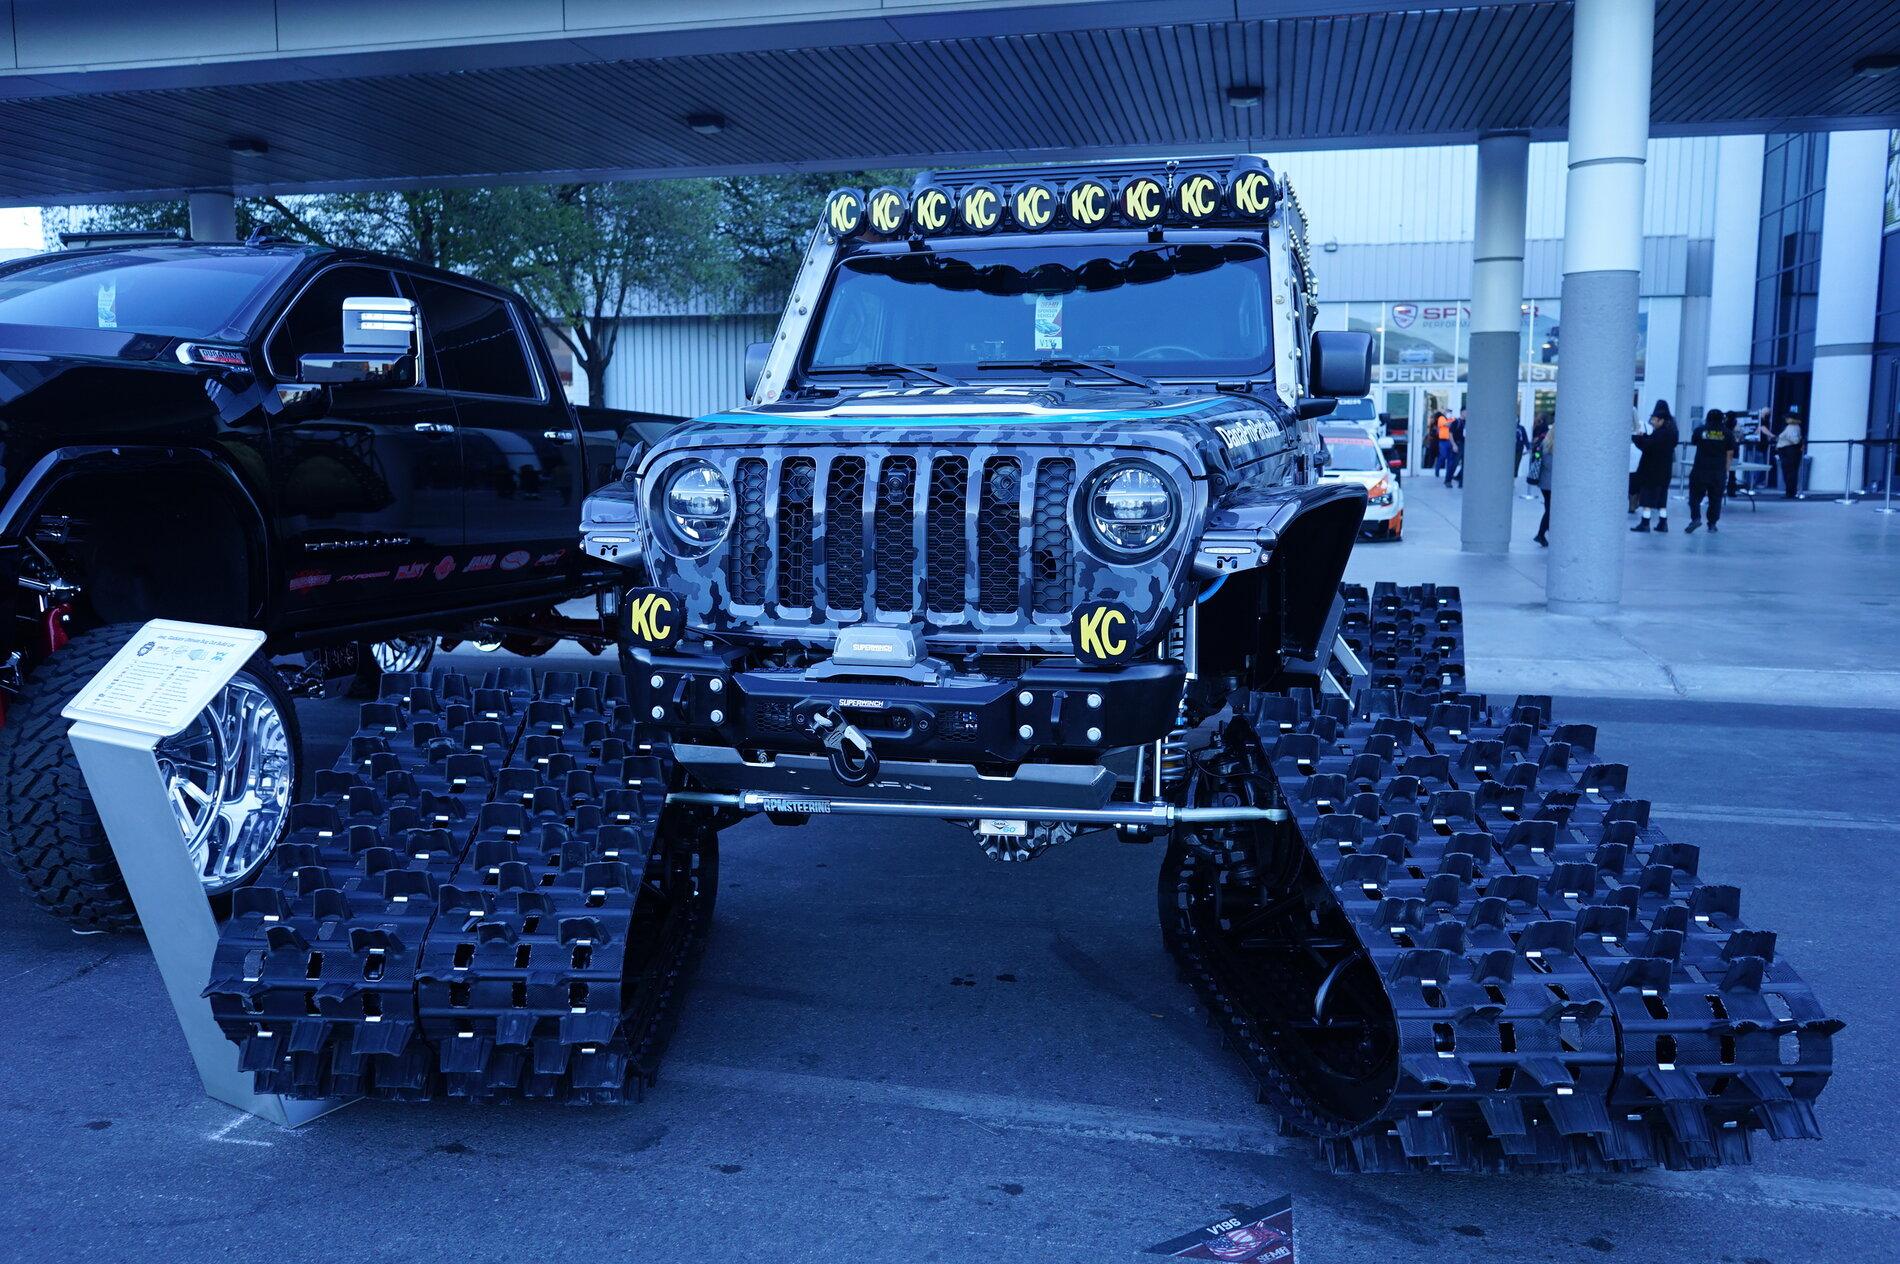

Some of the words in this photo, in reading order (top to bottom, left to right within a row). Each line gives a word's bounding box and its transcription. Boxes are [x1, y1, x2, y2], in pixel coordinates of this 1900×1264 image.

[872, 193, 899, 228] KC
[917, 193, 946, 228] KC
[965, 190, 995, 227] KC
[1018, 189, 1049, 225] KC
[1072, 185, 1104, 223] KC
[1127, 181, 1159, 220] KC
[1181, 177, 1214, 216] KC
[1236, 174, 1268, 212] KC
[831, 195, 856, 229] KC
[1383, 367, 1456, 382] DEFINE
[632, 593, 671, 642] KC
[1080, 606, 1127, 659] KC
[838, 698, 884, 709] SUPERWINCH
[1206, 1217, 1242, 1236] V196
